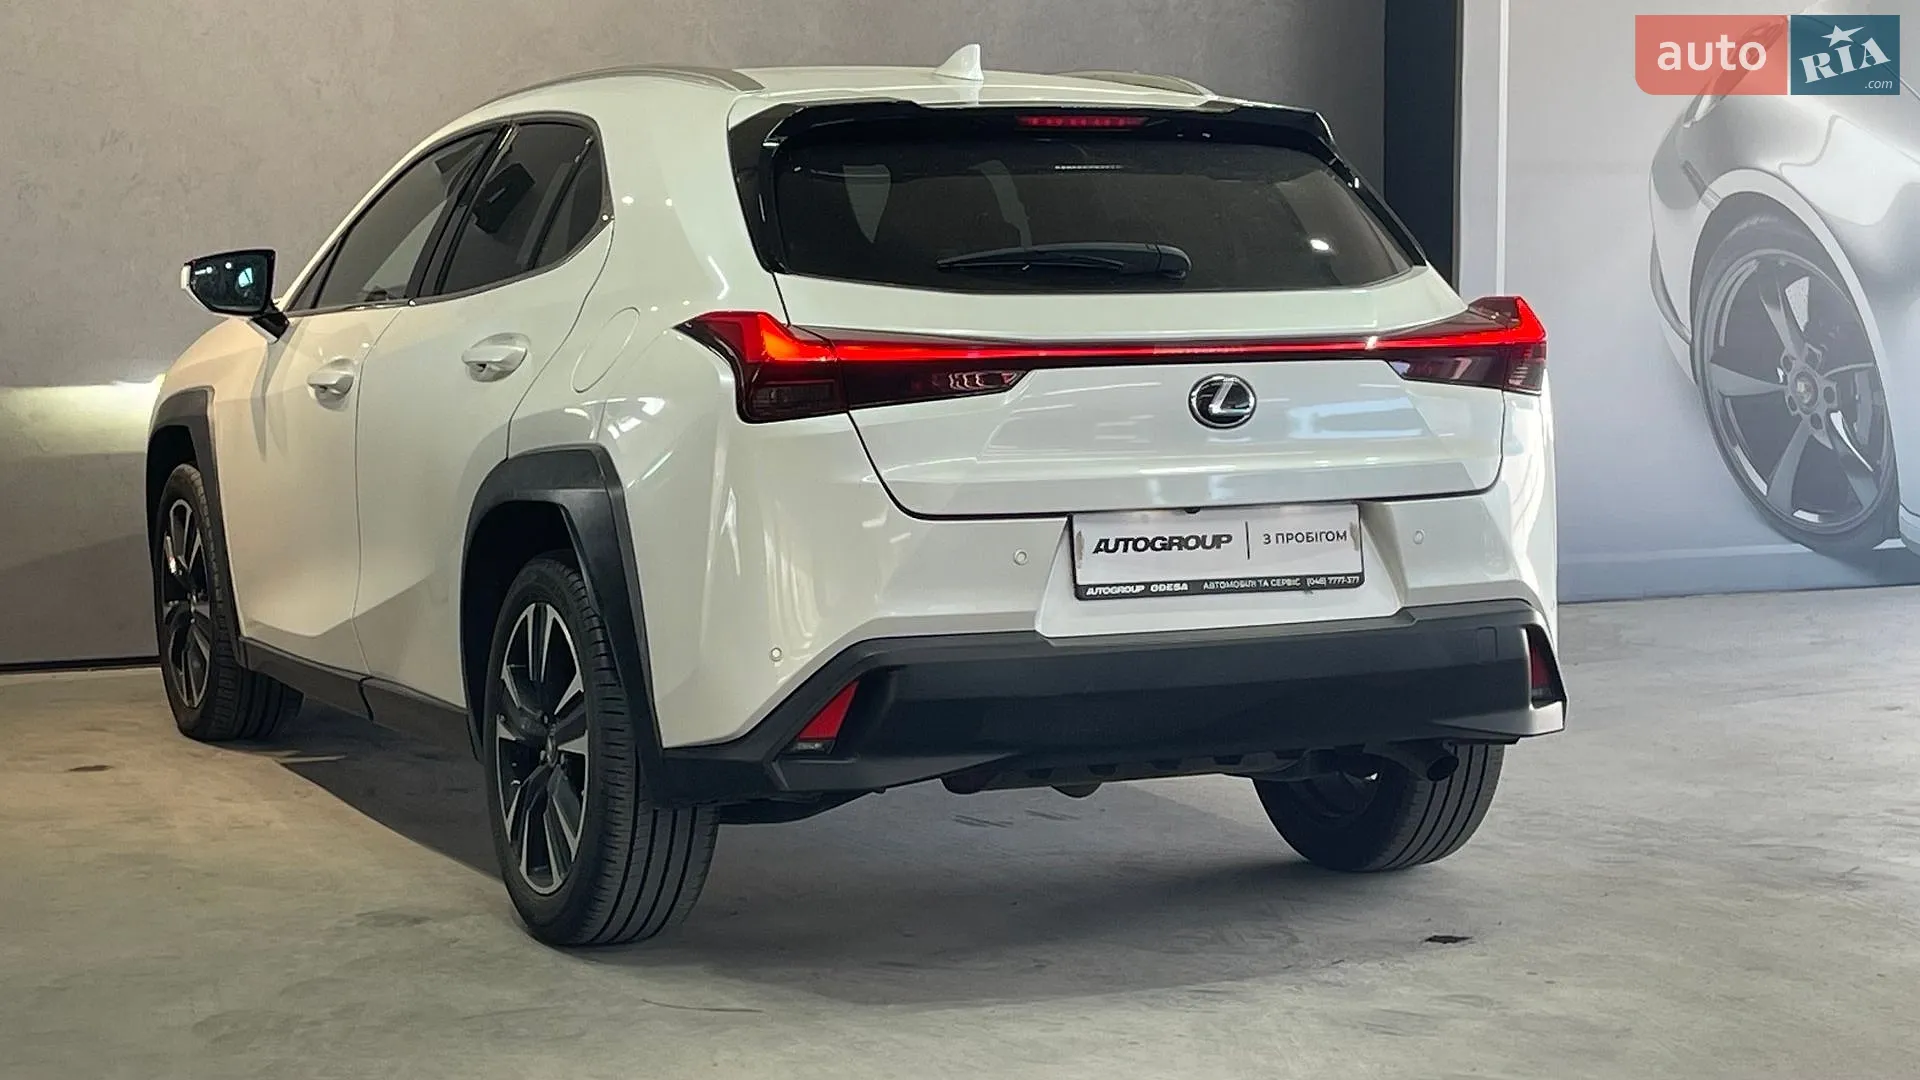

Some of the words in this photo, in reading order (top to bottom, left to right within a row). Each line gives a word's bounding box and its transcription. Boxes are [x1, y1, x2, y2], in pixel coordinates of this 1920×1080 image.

[1093, 533, 1232, 554] AUTOGROUP
[1275, 531, 1347, 544] ПРОБІГОМ
[1086, 585, 1145, 596] AUTOGROUP
[1150, 583, 1189, 592] ODESA
